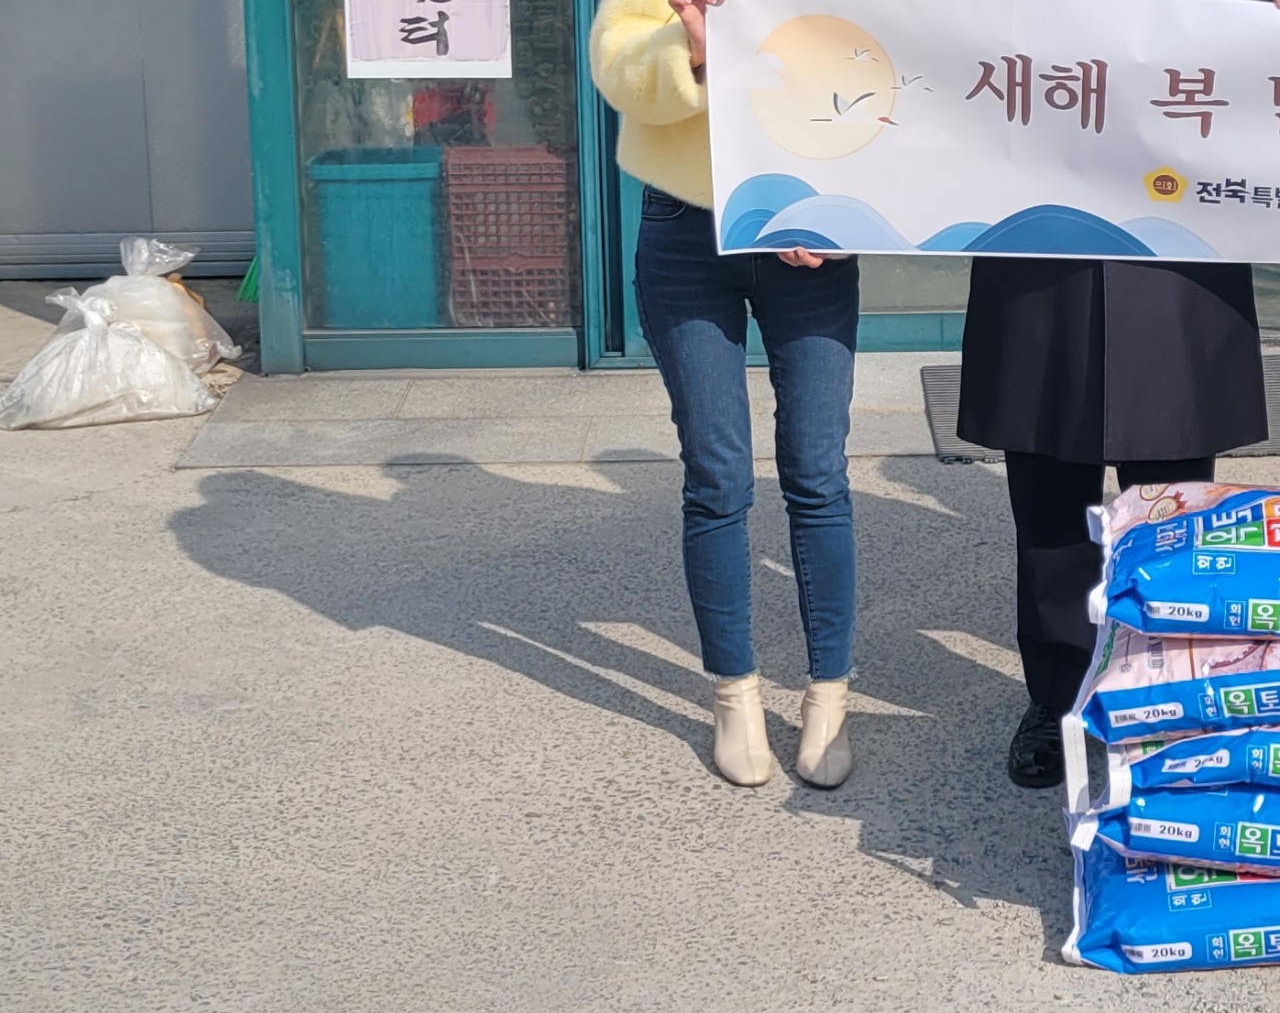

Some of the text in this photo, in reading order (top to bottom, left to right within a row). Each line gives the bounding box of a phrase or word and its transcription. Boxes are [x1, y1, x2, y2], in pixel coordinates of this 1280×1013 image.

[965, 53, 1108, 134] 새해
[1149, 67, 1230, 139] 복
[1168, 605, 1203, 619] 20kg
[1143, 709, 1178, 720] 20kg
[1159, 824, 1193, 838] 20kg
[1151, 947, 1186, 958] 20kg
